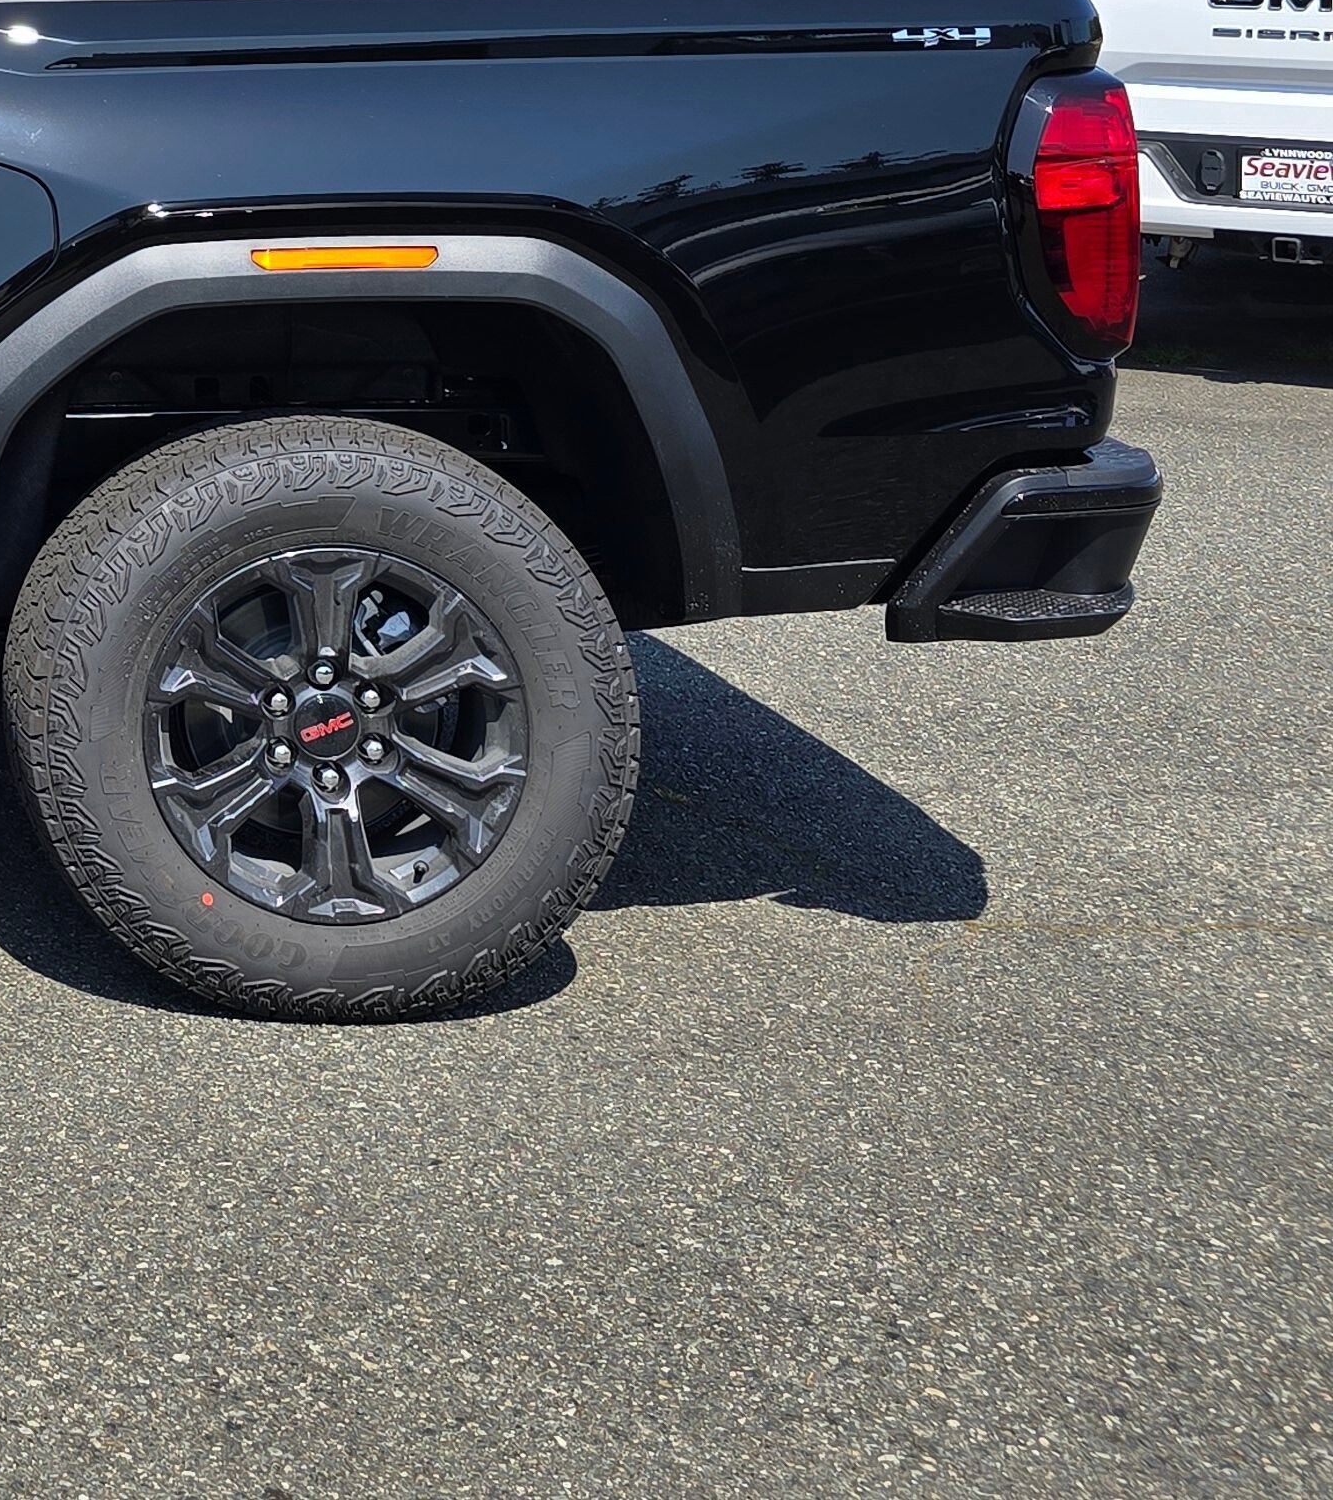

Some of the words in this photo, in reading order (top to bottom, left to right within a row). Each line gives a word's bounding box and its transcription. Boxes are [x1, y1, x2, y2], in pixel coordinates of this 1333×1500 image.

[1244, 157, 1333, 181] Seavie
[1260, 180, 1300, 192] BUICK
[376, 505, 582, 709] WRANGLER
[300, 711, 355, 742] GMC
[99, 762, 309, 971] GOODYEAR
